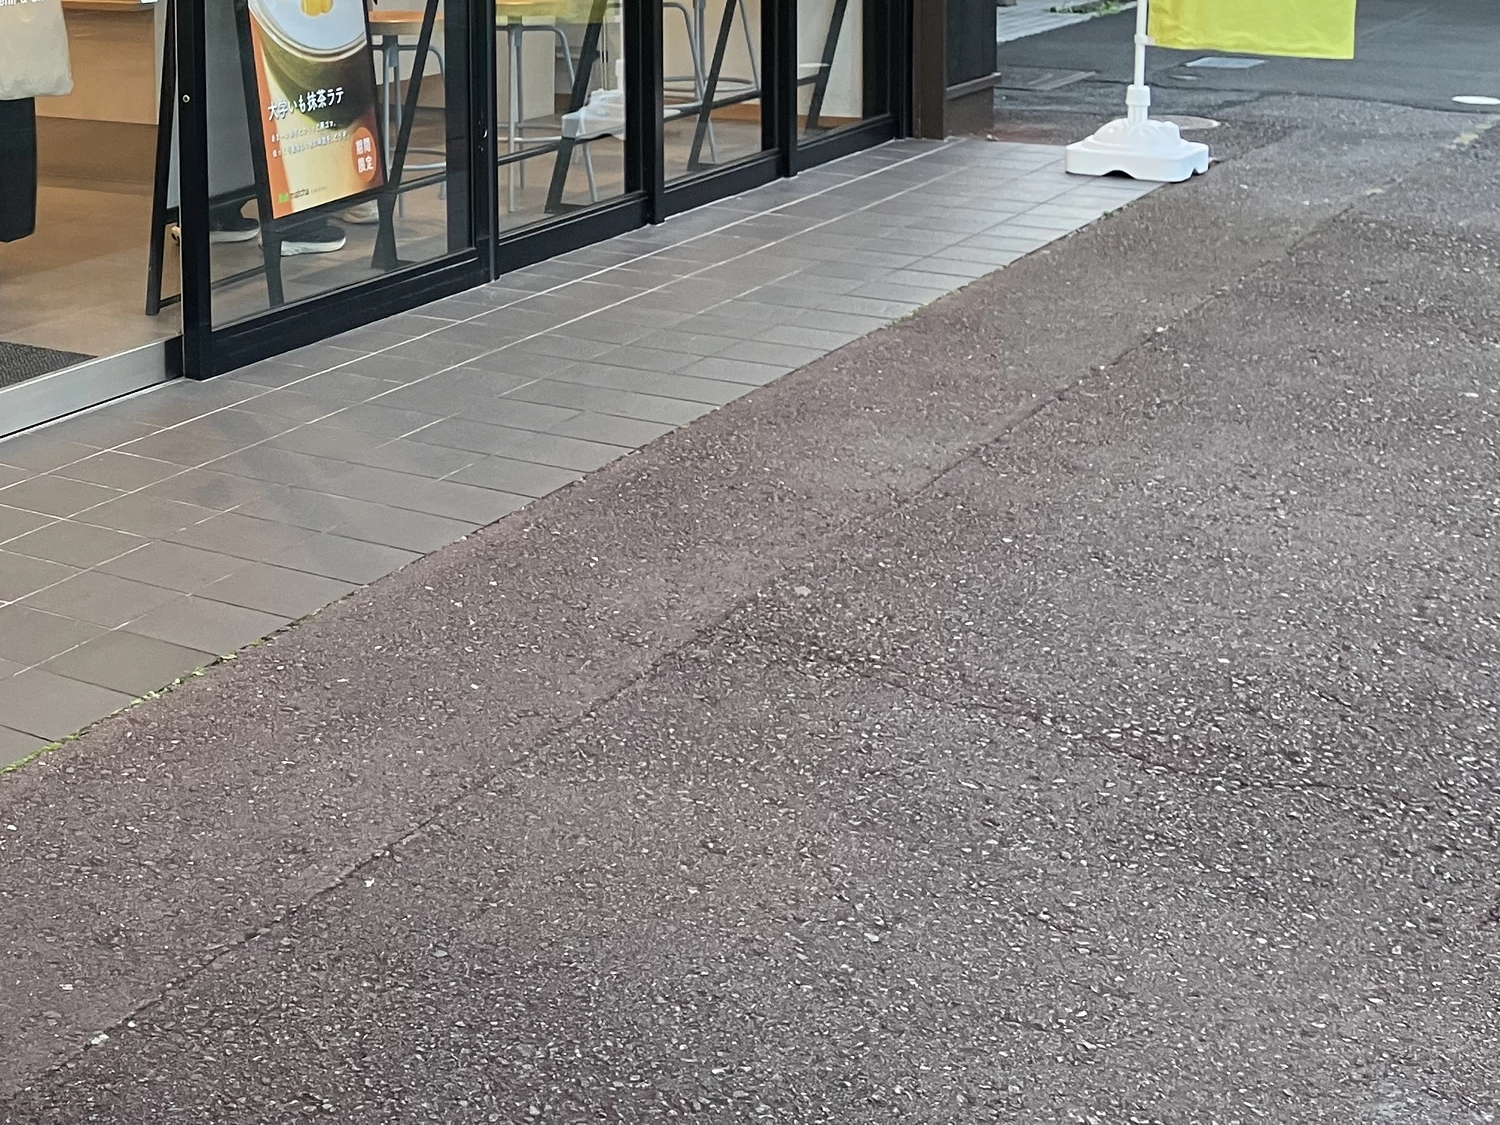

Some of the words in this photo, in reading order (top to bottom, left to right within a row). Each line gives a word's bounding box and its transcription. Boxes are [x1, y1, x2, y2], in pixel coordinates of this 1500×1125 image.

[268, 87, 344, 121] 大学いも抹茶ラテ
